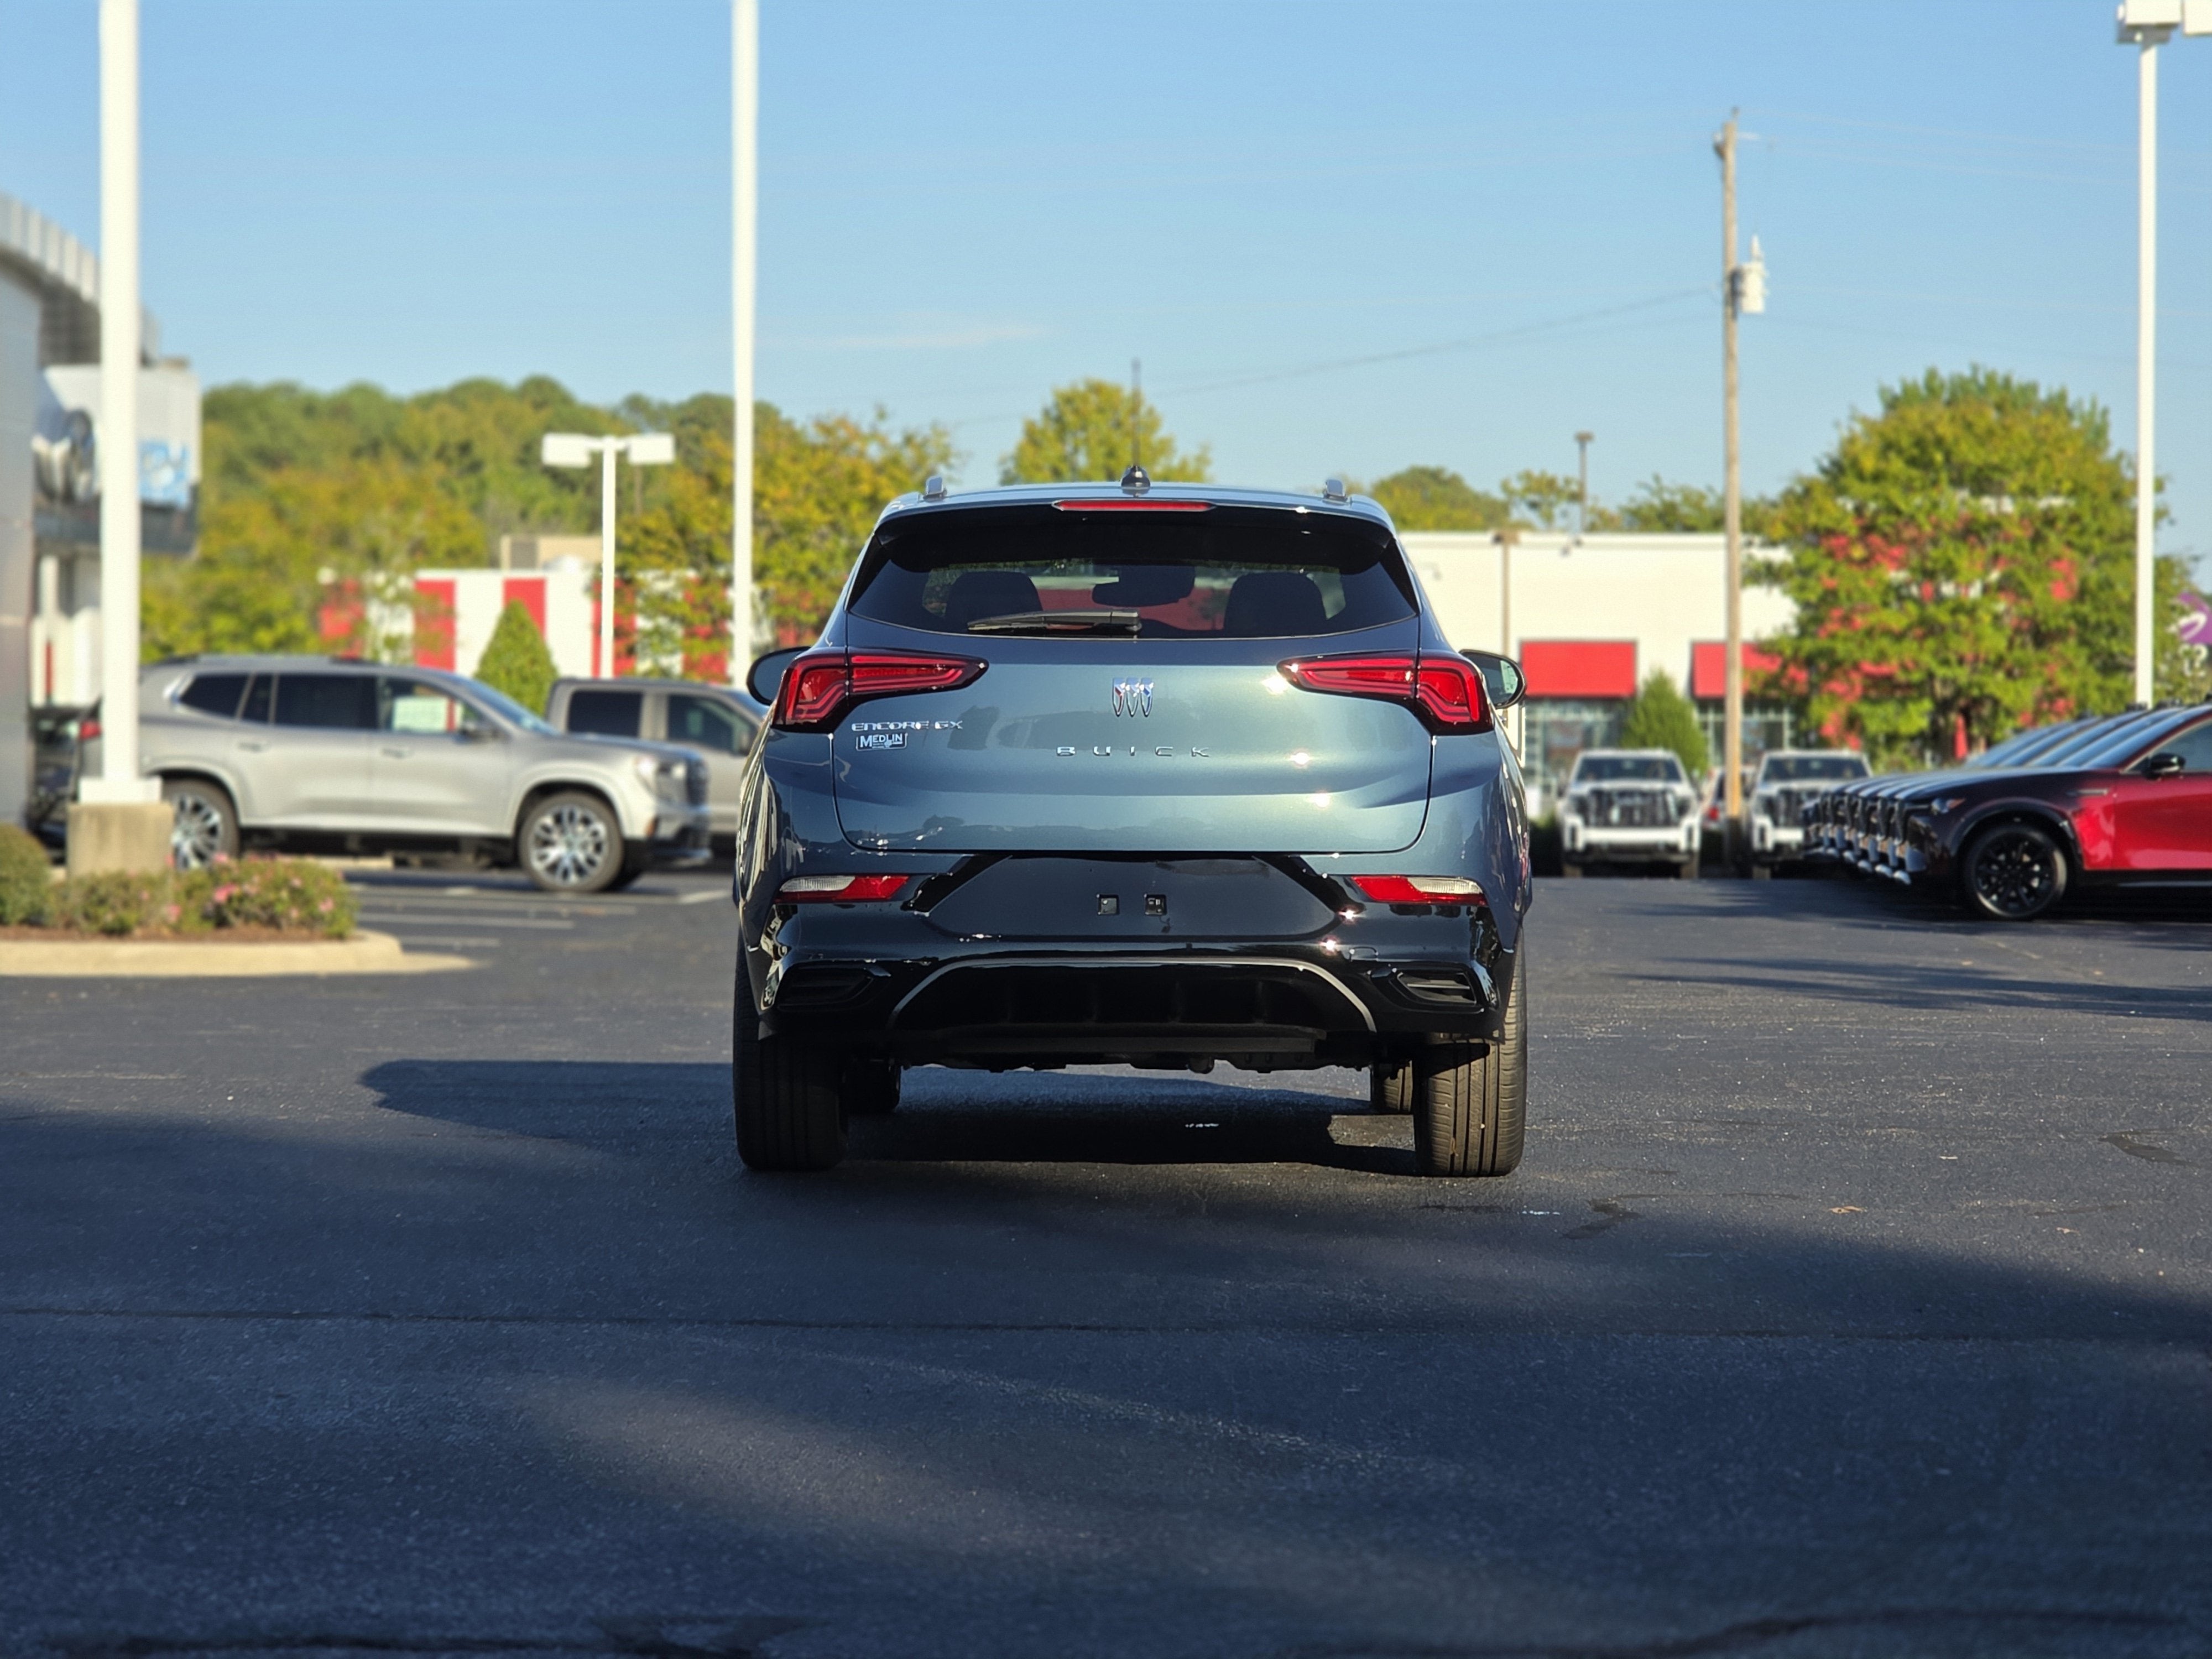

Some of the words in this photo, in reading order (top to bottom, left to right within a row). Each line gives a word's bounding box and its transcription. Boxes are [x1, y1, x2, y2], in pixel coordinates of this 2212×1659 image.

[852, 721, 929, 732] ENCORE
[935, 721, 963, 729] GX
[859, 733, 903, 748] MEDLIN
[1056, 746, 1209, 757] BUICK
